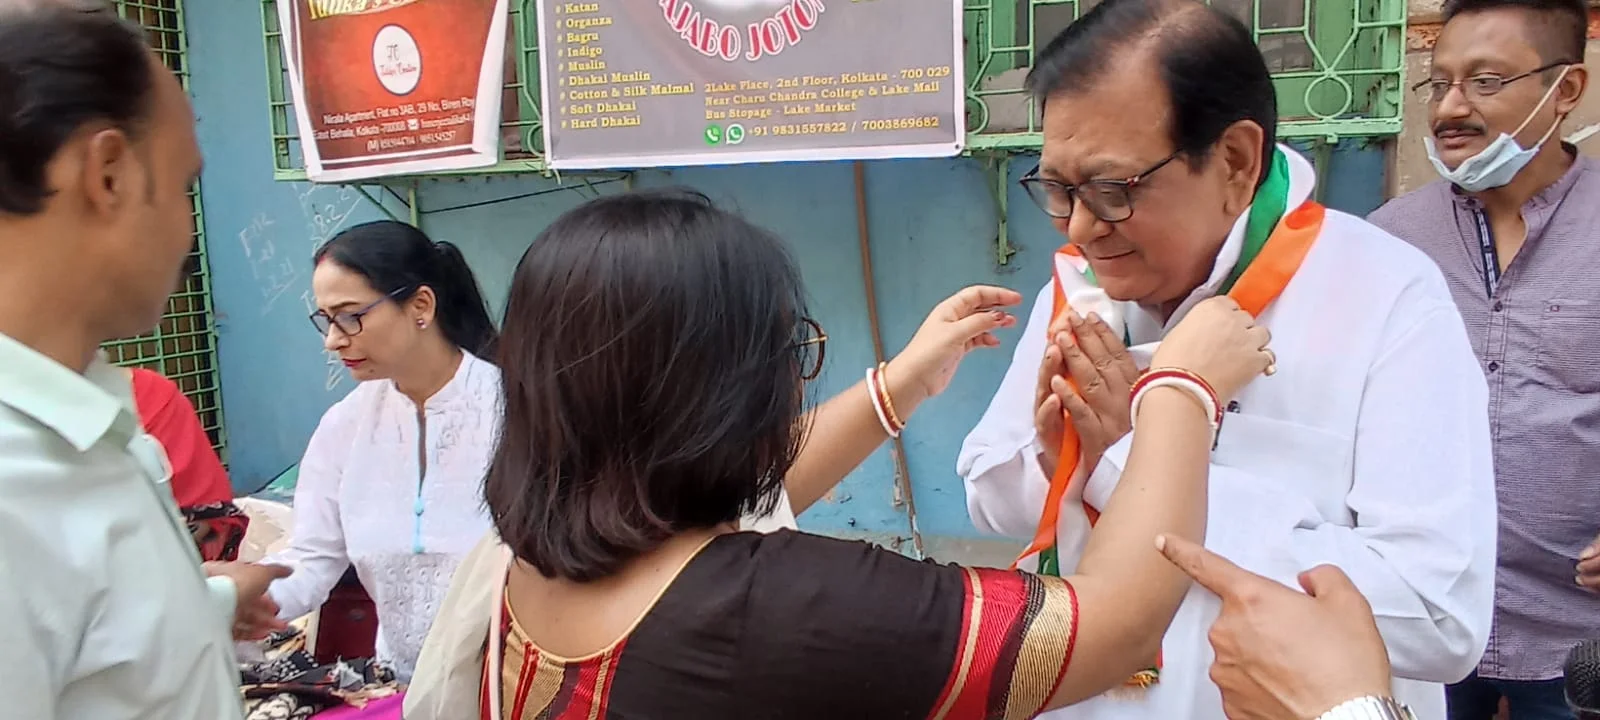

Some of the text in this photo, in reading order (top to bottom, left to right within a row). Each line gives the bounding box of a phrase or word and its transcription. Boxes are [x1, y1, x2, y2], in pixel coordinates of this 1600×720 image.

[565, 3, 599, 13] Katan
[566, 17, 612, 28] Organza
[746, 0, 825, 61] JOTO
[567, 33, 599, 43] Bagru
[567, 46, 602, 58] Indigo
[568, 60, 606, 72] Muslin
[611, 71, 651, 83] Muslin
[776, 78, 799, 89] 2nd
[841, 72, 888, 84] Kolkata
[900, 69, 923, 79] 700
[927, 67, 950, 78] 029
[569, 89, 608, 100] Cotton
[611, 87, 620, 98] &
[623, 85, 647, 97] Silk
[705, 82, 939, 106] Near Charu Chandra College & Lake Mall
[570, 104, 593, 115] Soft
[705, 110, 726, 120] Bus
[728, 107, 772, 120] Stopage
[784, 104, 811, 115] Lake
[815, 101, 856, 114] Market
[571, 117, 597, 129] Hard
[772, 121, 847, 136] 9831557822
[861, 116, 939, 130] 7003869682
